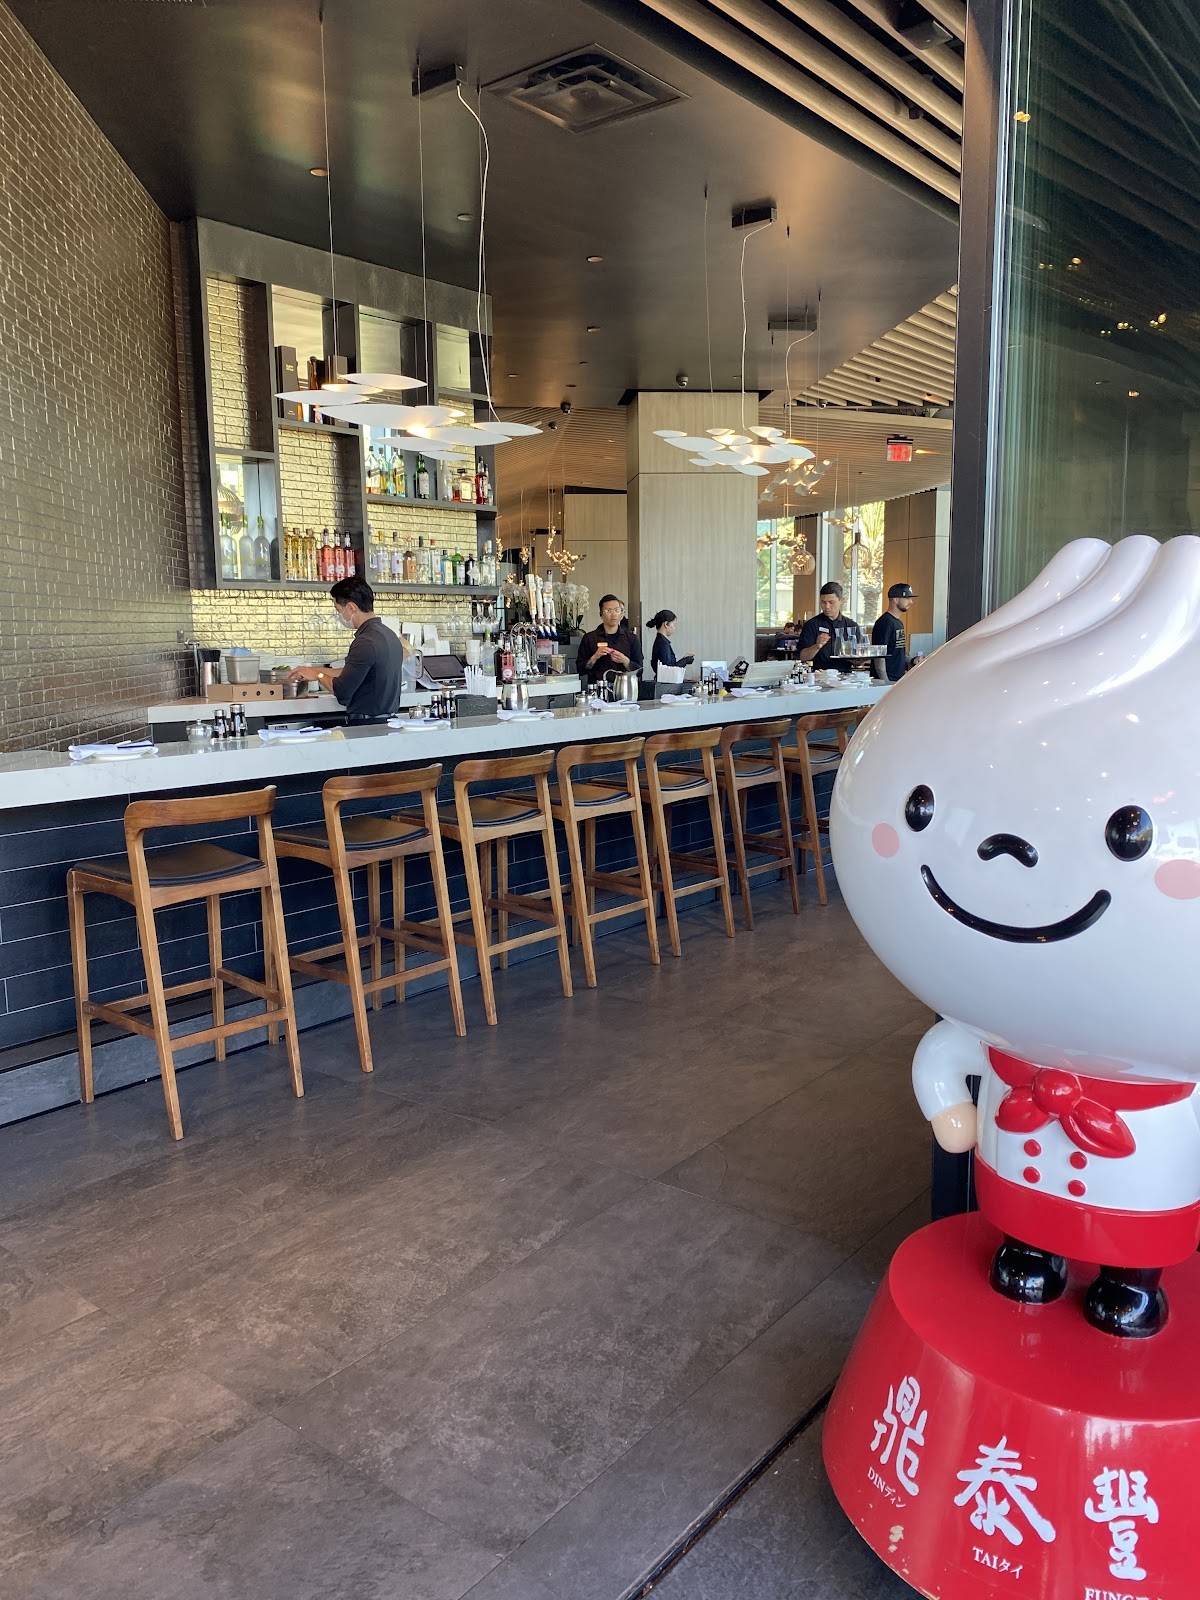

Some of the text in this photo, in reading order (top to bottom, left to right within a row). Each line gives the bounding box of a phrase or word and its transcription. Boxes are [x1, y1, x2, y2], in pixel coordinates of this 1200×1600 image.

[870, 1375, 1159, 1581] 鼎 泰 豐
